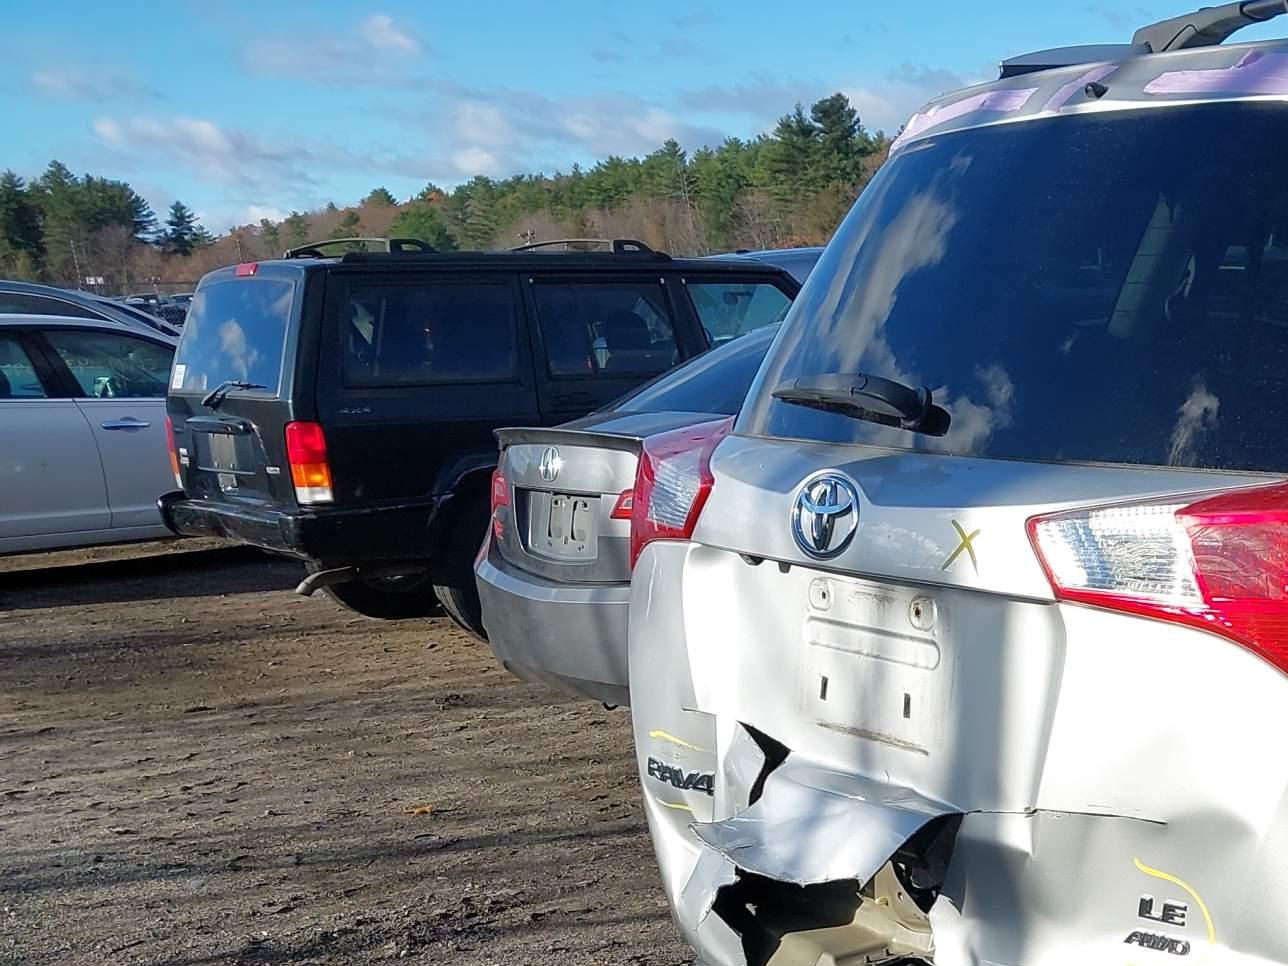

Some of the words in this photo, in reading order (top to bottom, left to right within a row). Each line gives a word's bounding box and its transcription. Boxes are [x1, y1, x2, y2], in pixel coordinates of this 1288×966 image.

[648, 756, 715, 796] RAV4
[1137, 896, 1188, 928] LE
[1123, 930, 1191, 957] AWD
